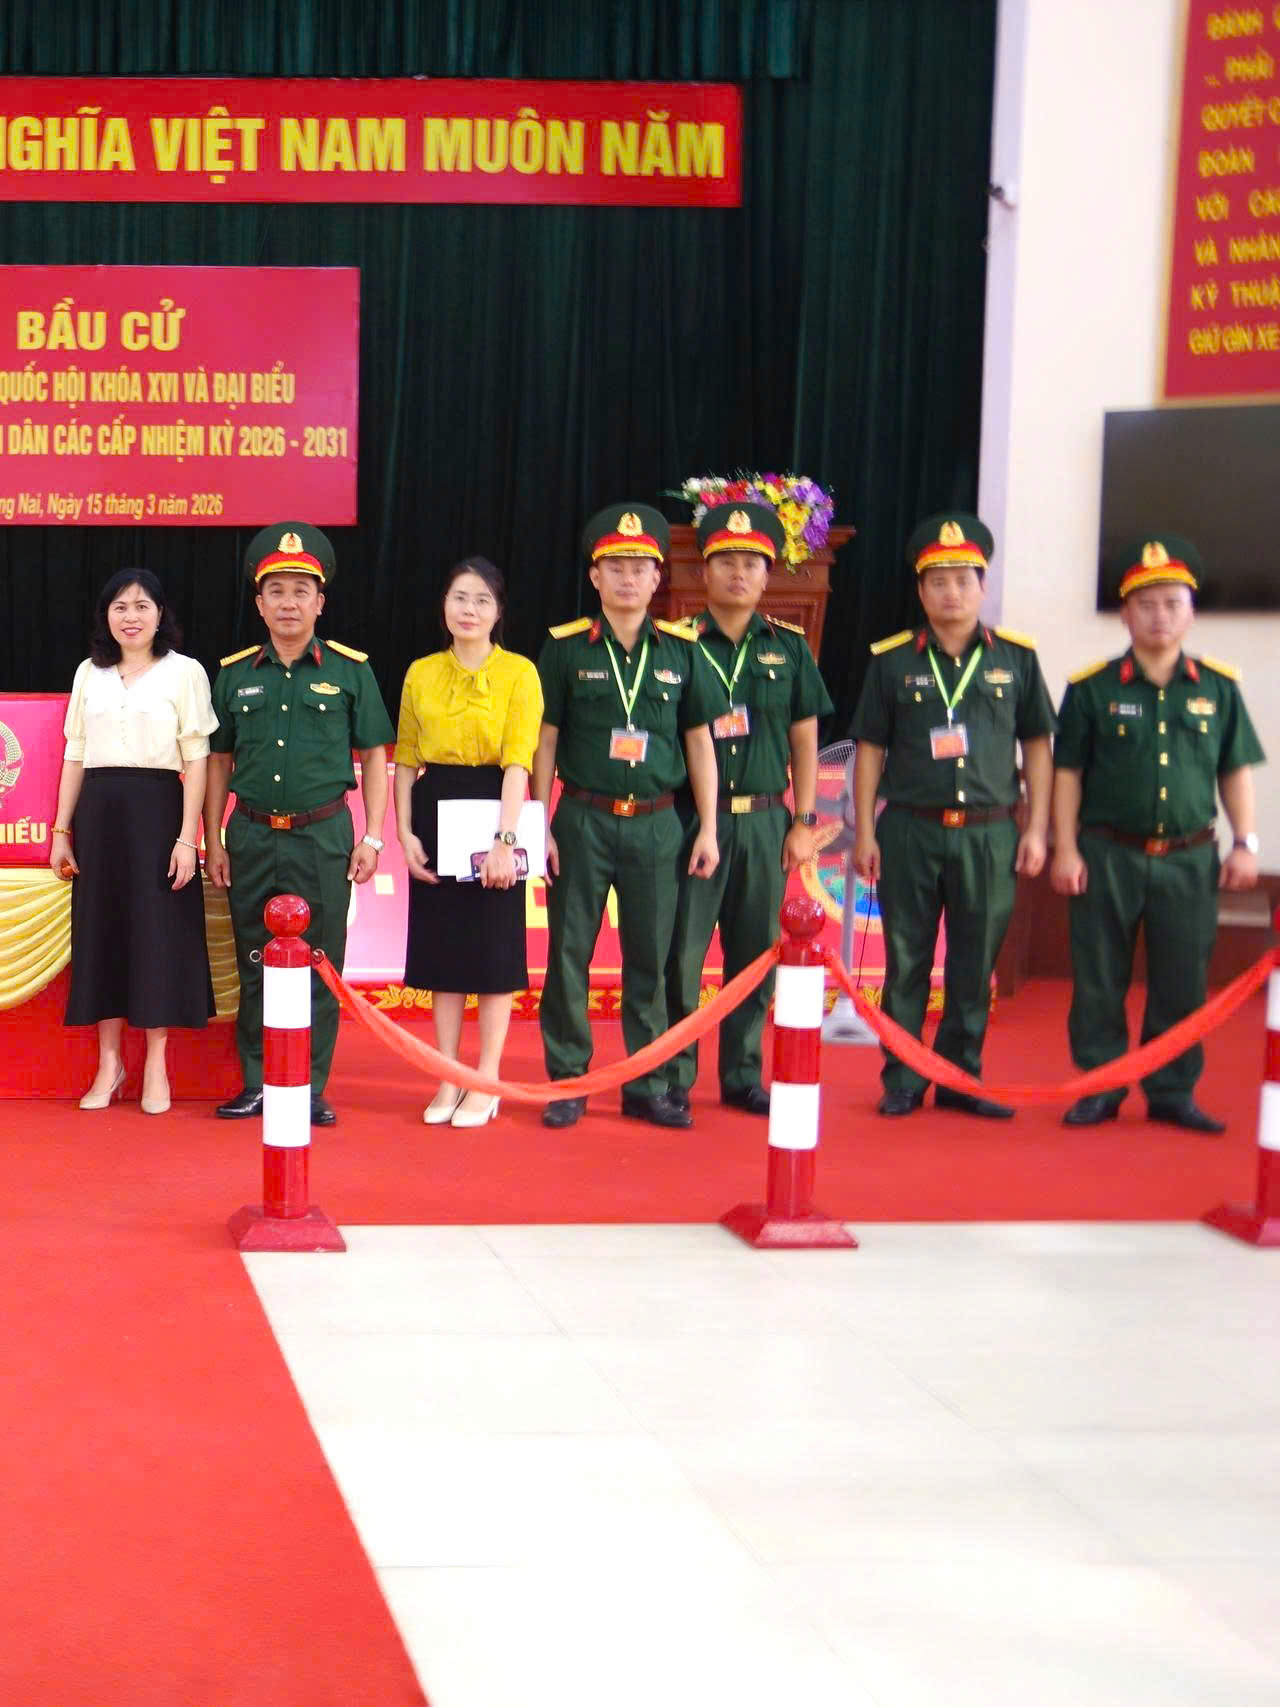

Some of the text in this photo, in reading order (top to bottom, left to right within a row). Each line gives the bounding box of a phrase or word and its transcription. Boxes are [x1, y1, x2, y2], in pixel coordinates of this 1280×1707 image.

[149, 106, 266, 184] VIỆT
[279, 117, 407, 172] NAM
[423, 107, 585, 175] MUÔN
[600, 110, 725, 178] NĂM
[17, 297, 187, 352] BẦU CỬ
[52, 365, 86, 409] HỘI
[90, 365, 143, 403] KHÓA
[147, 372, 179, 403] XVI
[183, 366, 209, 403] VÀ
[213, 372, 246, 410] ĐẠI
[250, 361, 295, 404] BIỂU
[8, 418, 49, 455] DÂN
[53, 418, 93, 456] CÁC
[97, 414, 137, 456] CẤP
[141, 419, 205, 462] NHIỆM
[209, 419, 235, 456] KỲ
[238, 425, 286, 457] 2026
[290, 439, 299, 447] -
[303, 426, 348, 457] 2031
[17, 492, 44, 519] Nai,
[47, 492, 83, 520] Ngày
[86, 493, 103, 515] 15
[104, 493, 144, 520] tháng
[146, 493, 156, 515] 3
[158, 493, 188, 515] năm
[190, 493, 223, 515] 2026
